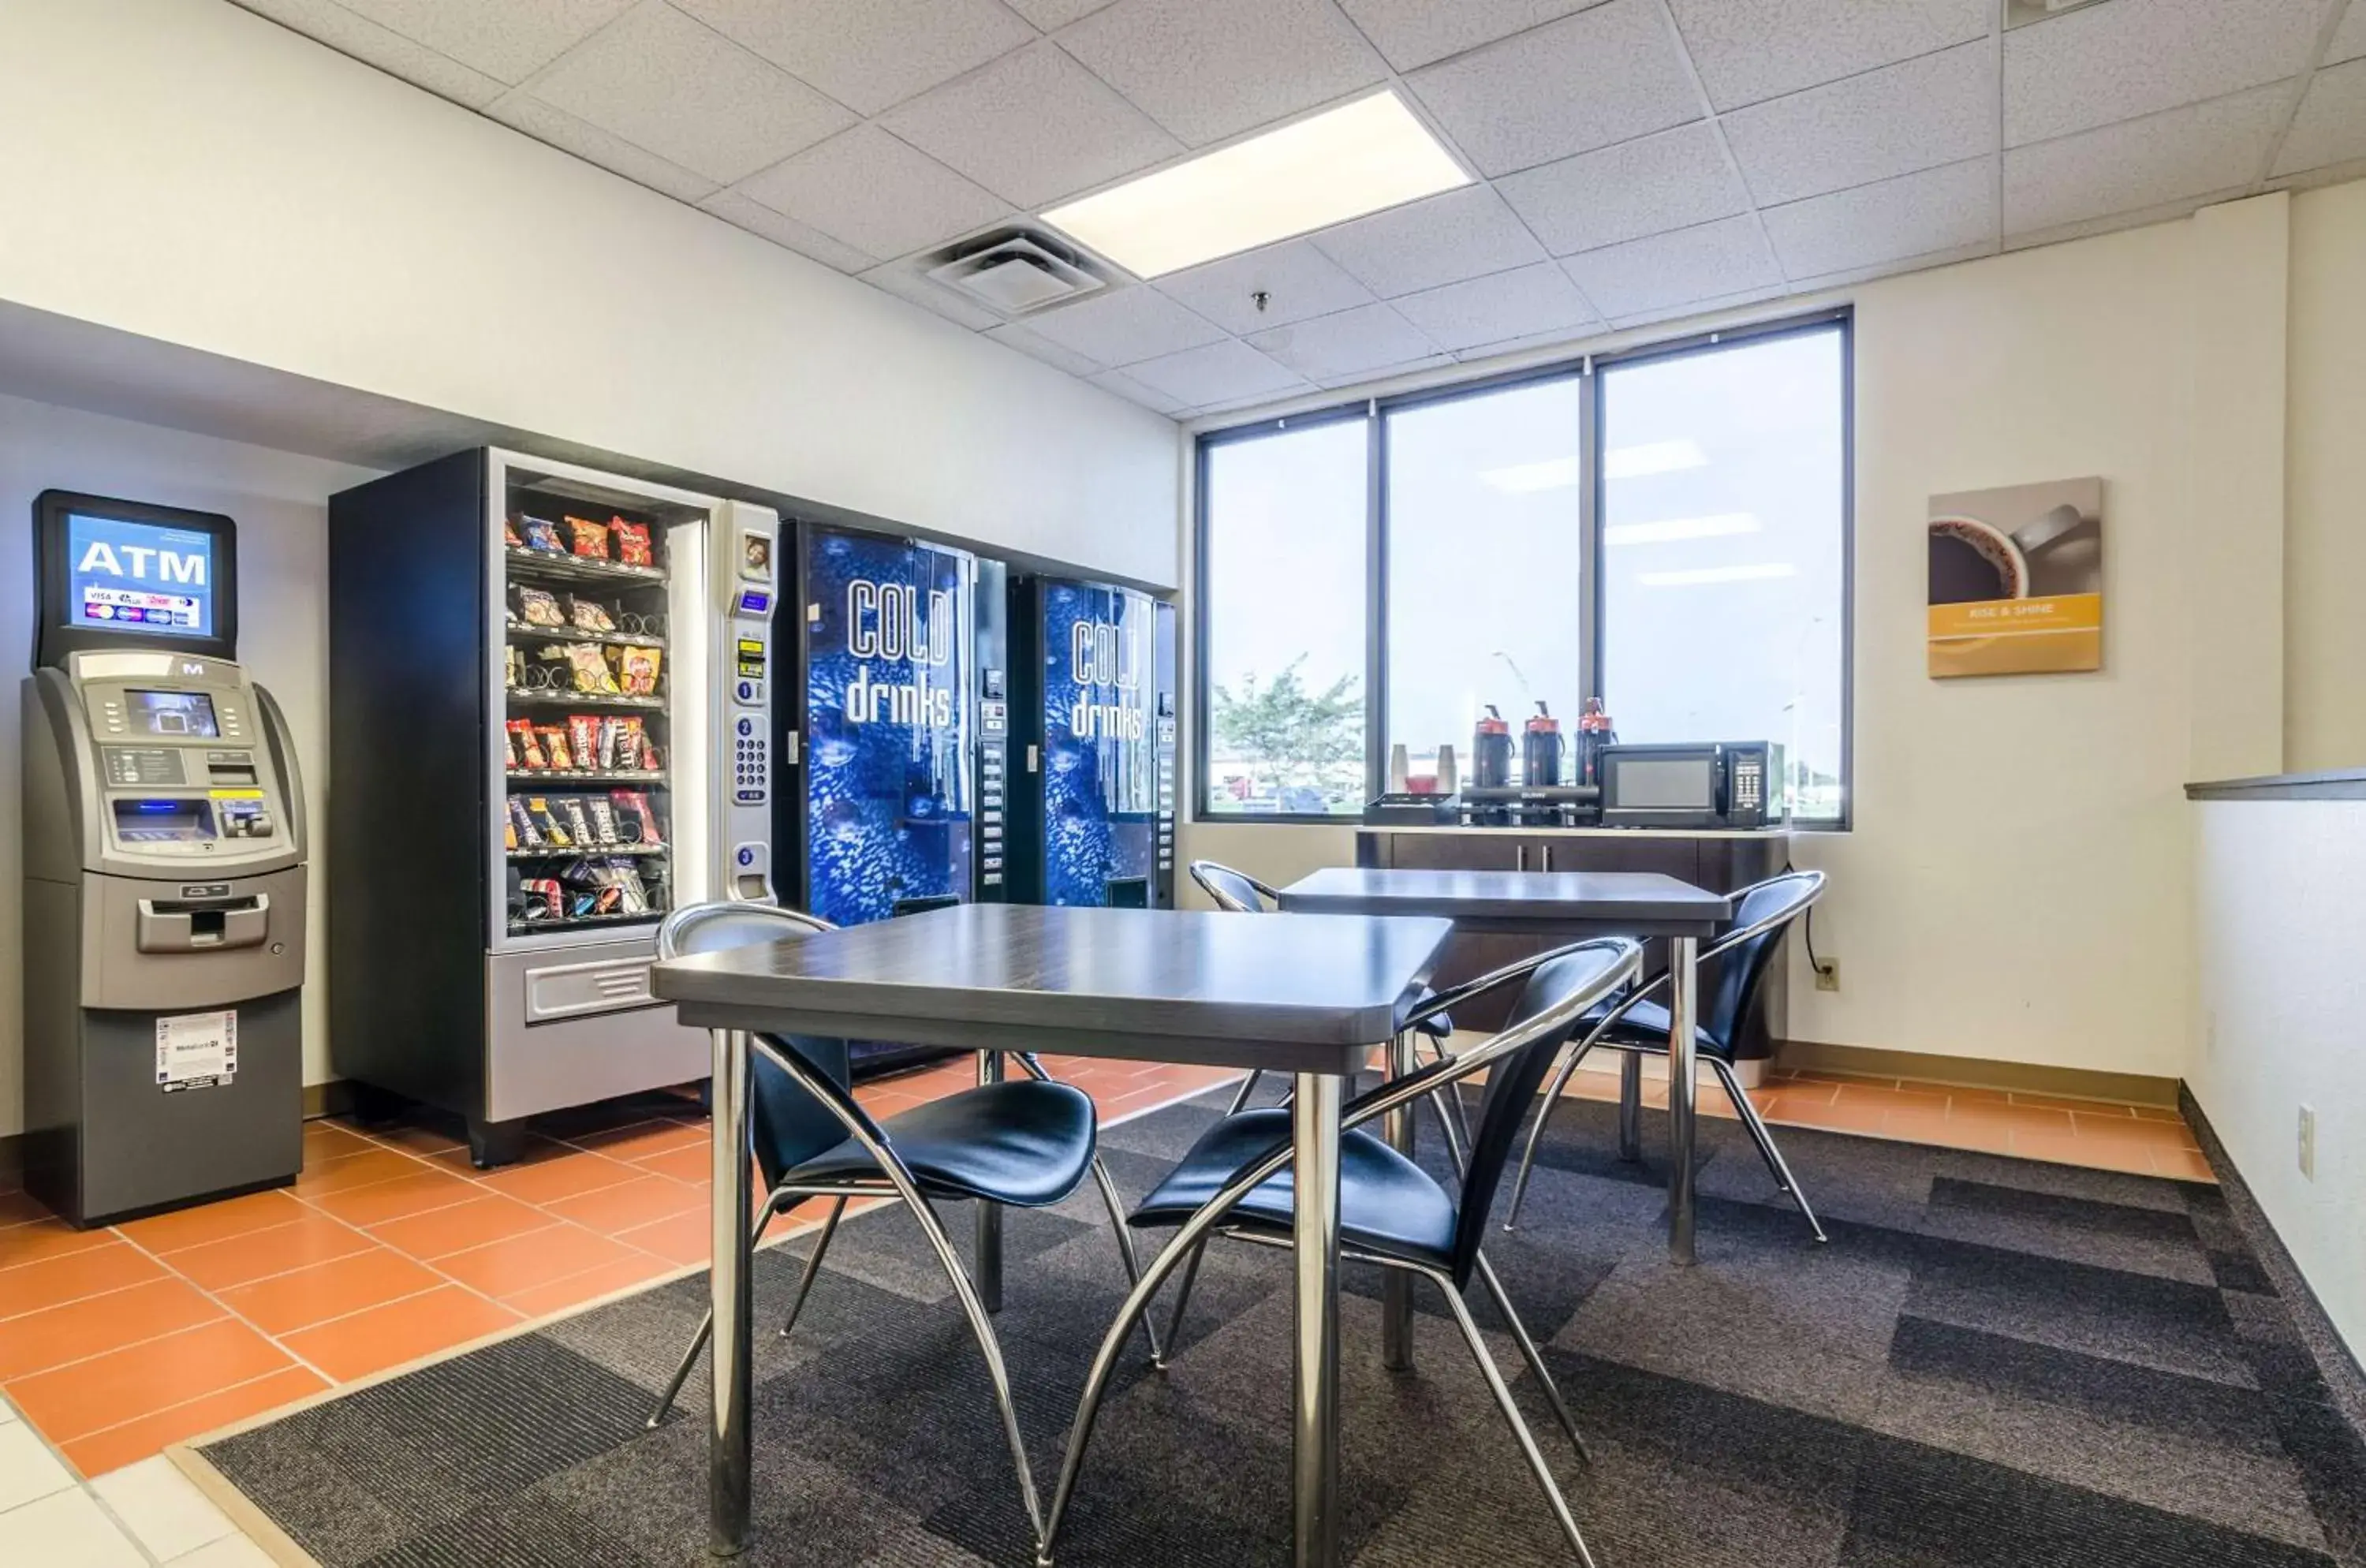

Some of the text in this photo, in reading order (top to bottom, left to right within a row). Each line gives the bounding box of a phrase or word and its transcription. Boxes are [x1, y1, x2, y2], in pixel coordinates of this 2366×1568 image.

[79, 542, 206, 585] ATM
[848, 580, 949, 665] COLD
[1969, 604, 2054, 618] RISE & SHINE
[847, 665, 950, 728] drinks
[1072, 689, 1143, 741] drinks
